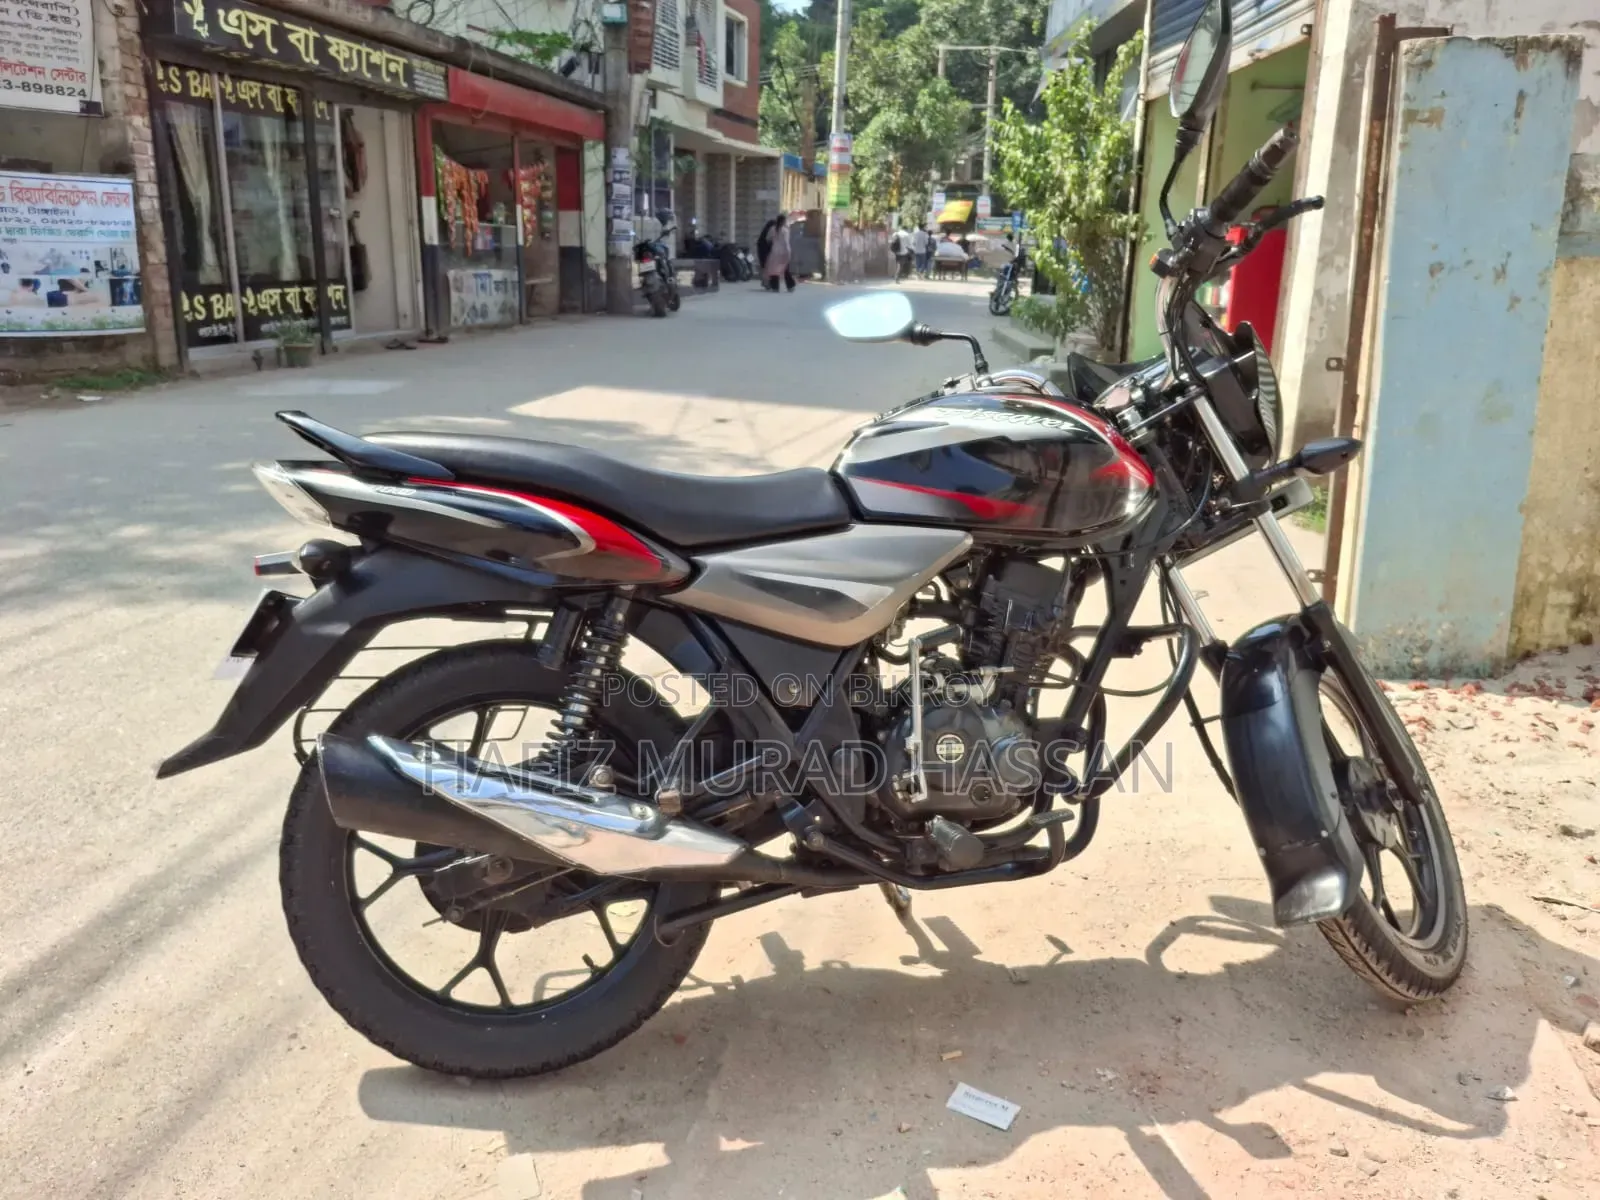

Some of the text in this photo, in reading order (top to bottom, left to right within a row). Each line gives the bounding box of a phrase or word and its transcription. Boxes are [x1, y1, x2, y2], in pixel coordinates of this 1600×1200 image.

[217, 8, 279, 54] এস
[283, 22, 319, 65] বা
[323, 34, 408, 88] ফ্যাশন
[168, 66, 182, 94] S
[193, 294, 206, 321] S
